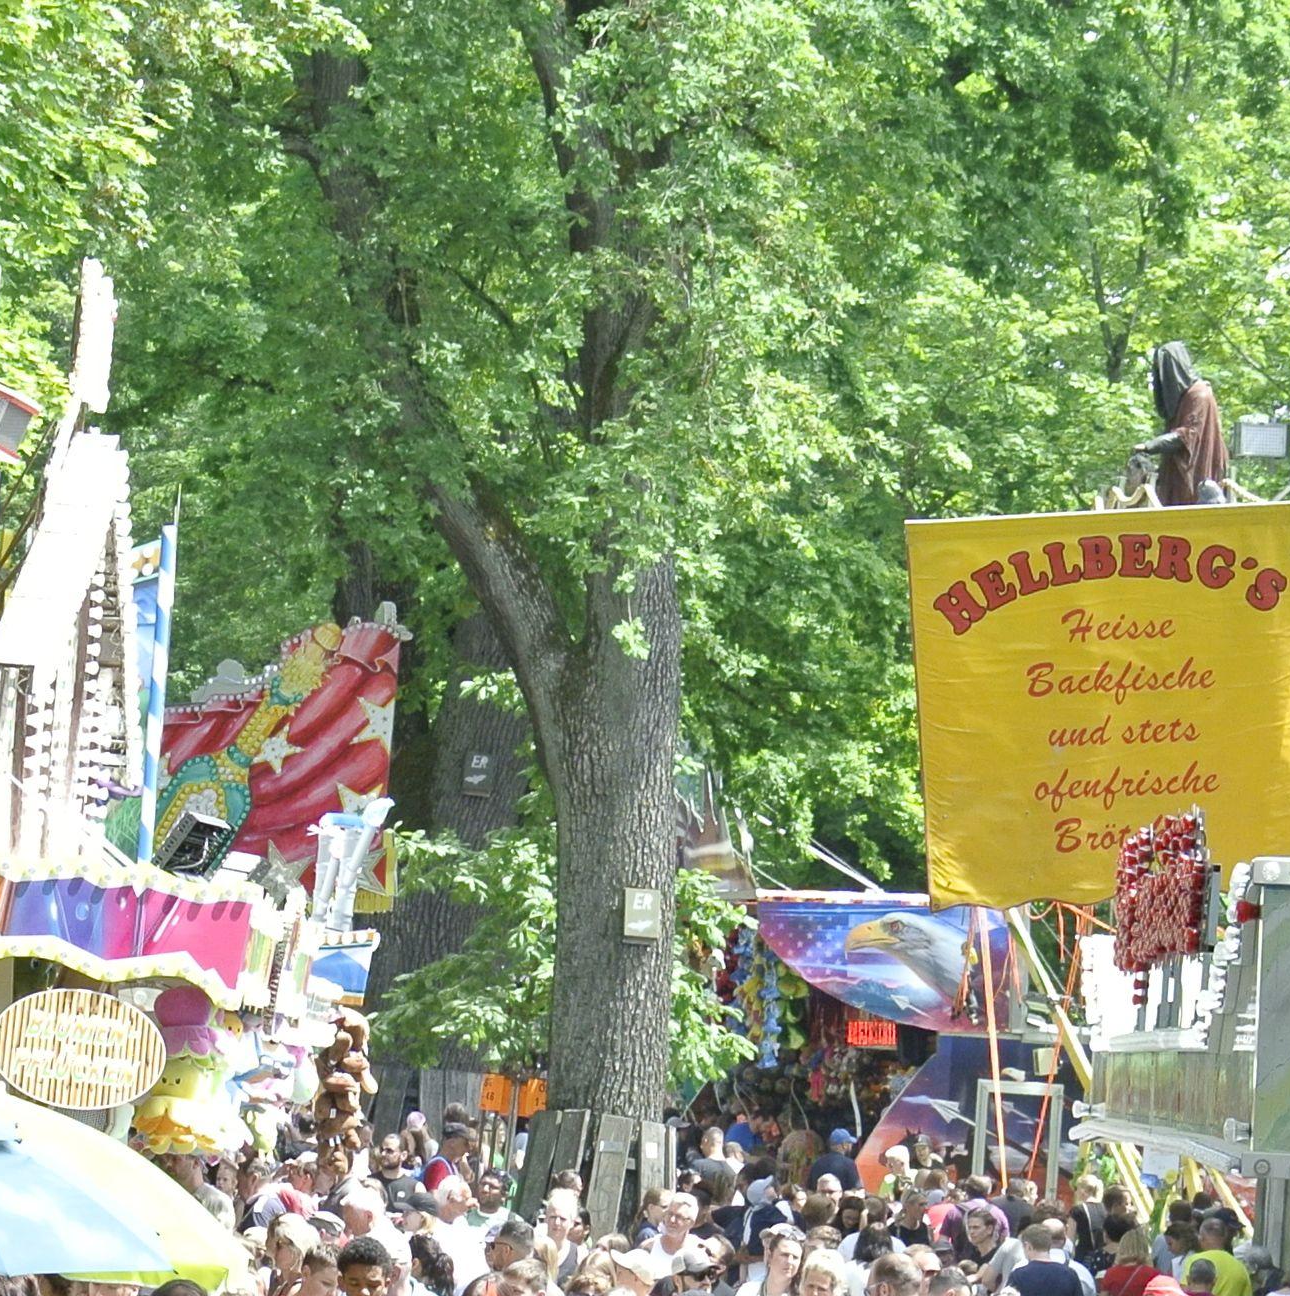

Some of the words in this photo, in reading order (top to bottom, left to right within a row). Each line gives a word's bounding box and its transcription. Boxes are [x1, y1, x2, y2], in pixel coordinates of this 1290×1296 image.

[1061, 608, 1176, 644] Heisse
[1026, 657, 1217, 706] Backfische
[1048, 716, 1111, 748] und
[1122, 719, 1200, 746] stets
[471, 755, 489, 769] ER
[1034, 762, 1220, 814] ofenfrische
[633, 892, 654, 910] ER
